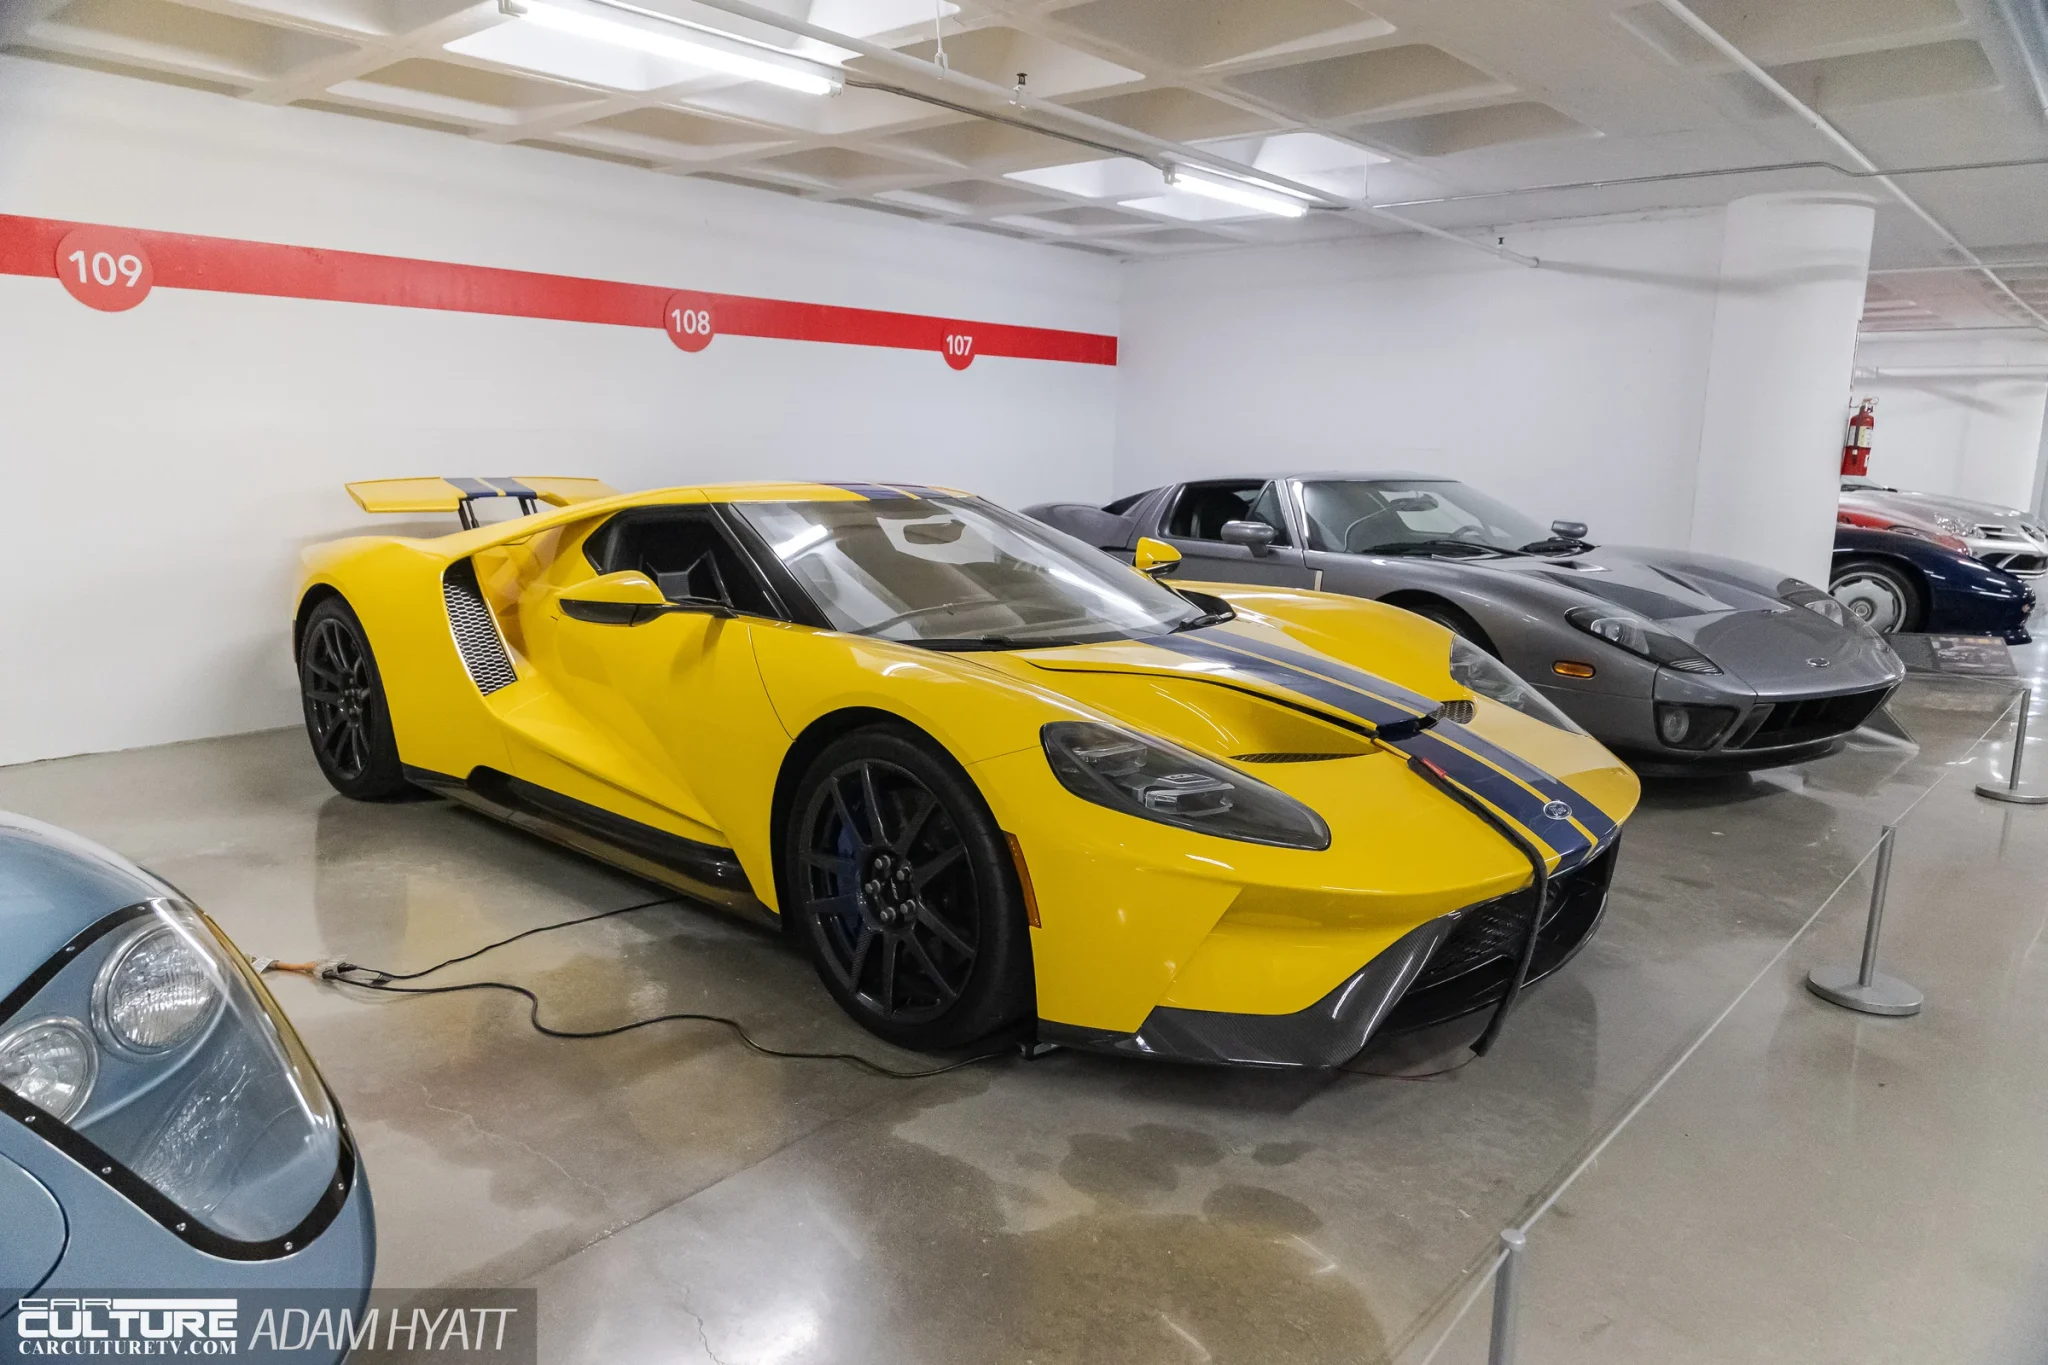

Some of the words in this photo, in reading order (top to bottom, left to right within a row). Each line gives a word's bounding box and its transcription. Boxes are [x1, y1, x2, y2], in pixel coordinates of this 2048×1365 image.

[68, 250, 143, 288] 109
[671, 309, 711, 335] 108
[946, 334, 973, 356] 107
